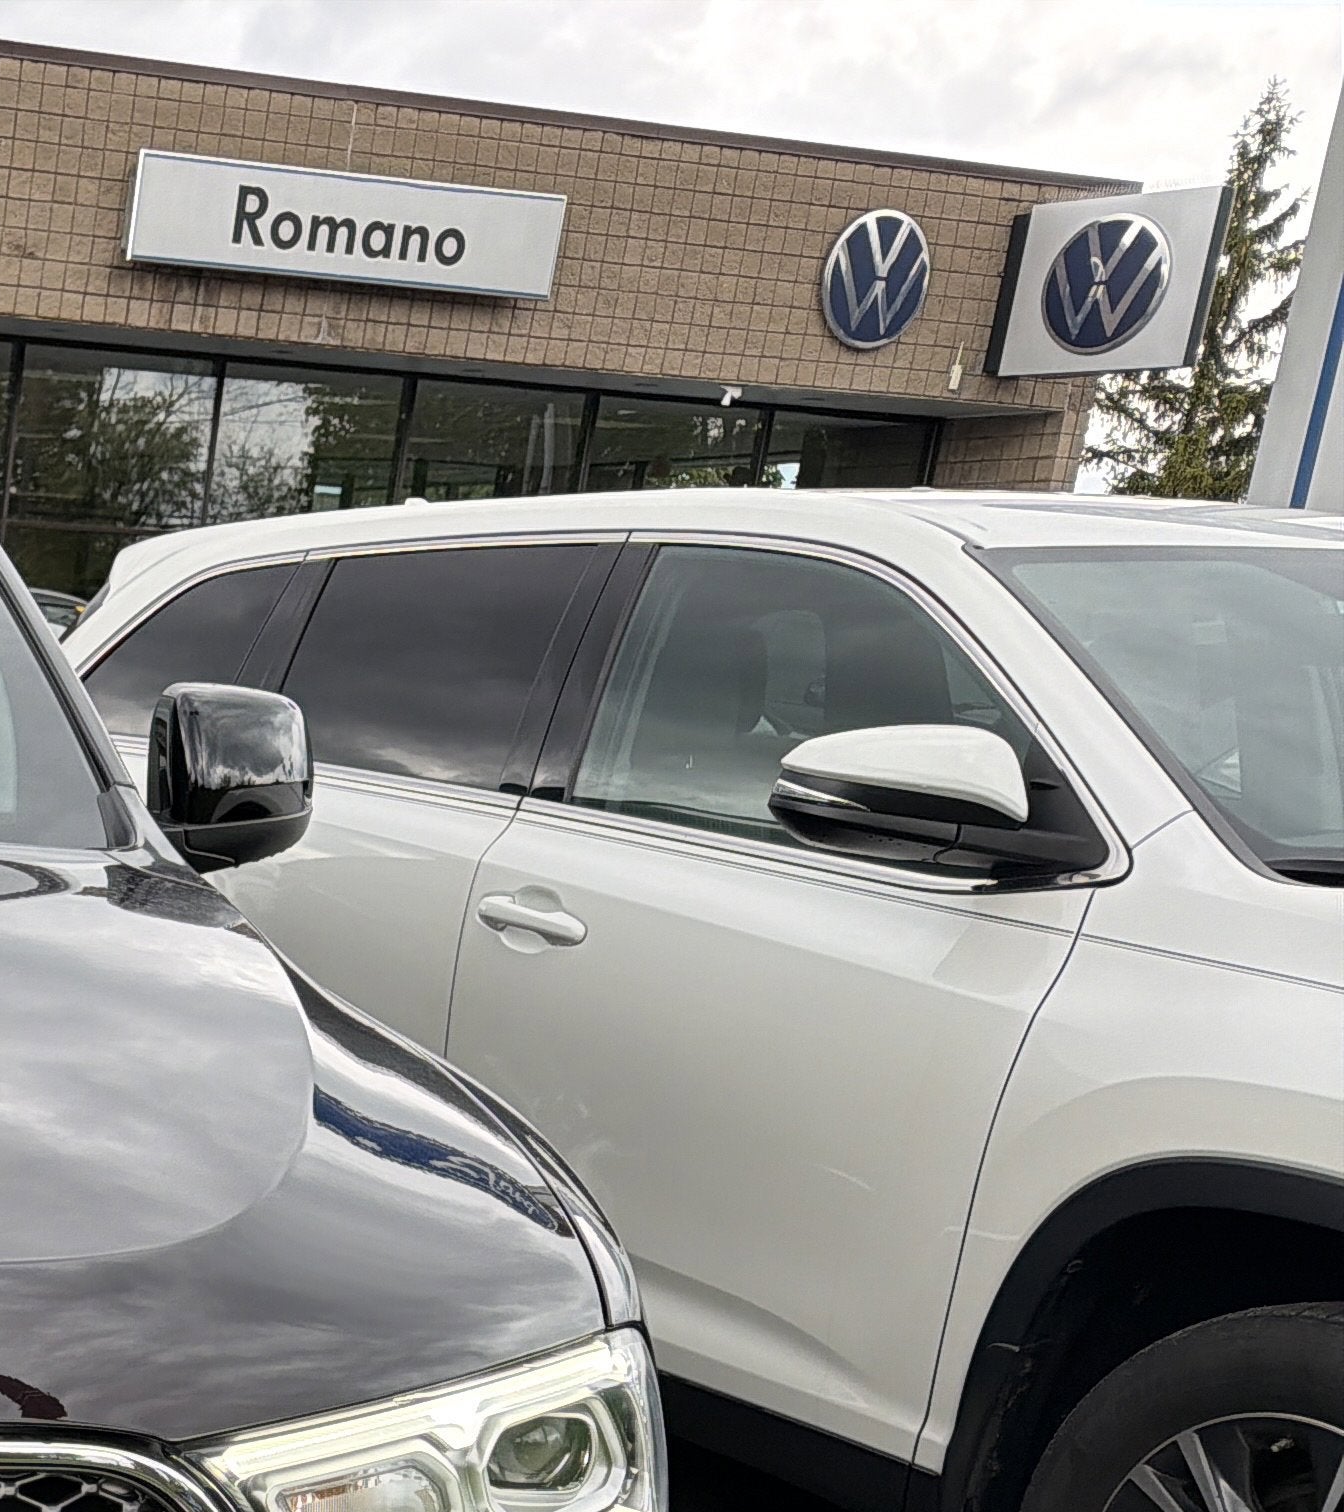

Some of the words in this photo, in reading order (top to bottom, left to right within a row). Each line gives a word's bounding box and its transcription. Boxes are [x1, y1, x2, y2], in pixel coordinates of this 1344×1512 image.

[231, 184, 466, 267] Romano
[826, 212, 928, 341] VW
[1049, 216, 1167, 345] VW
